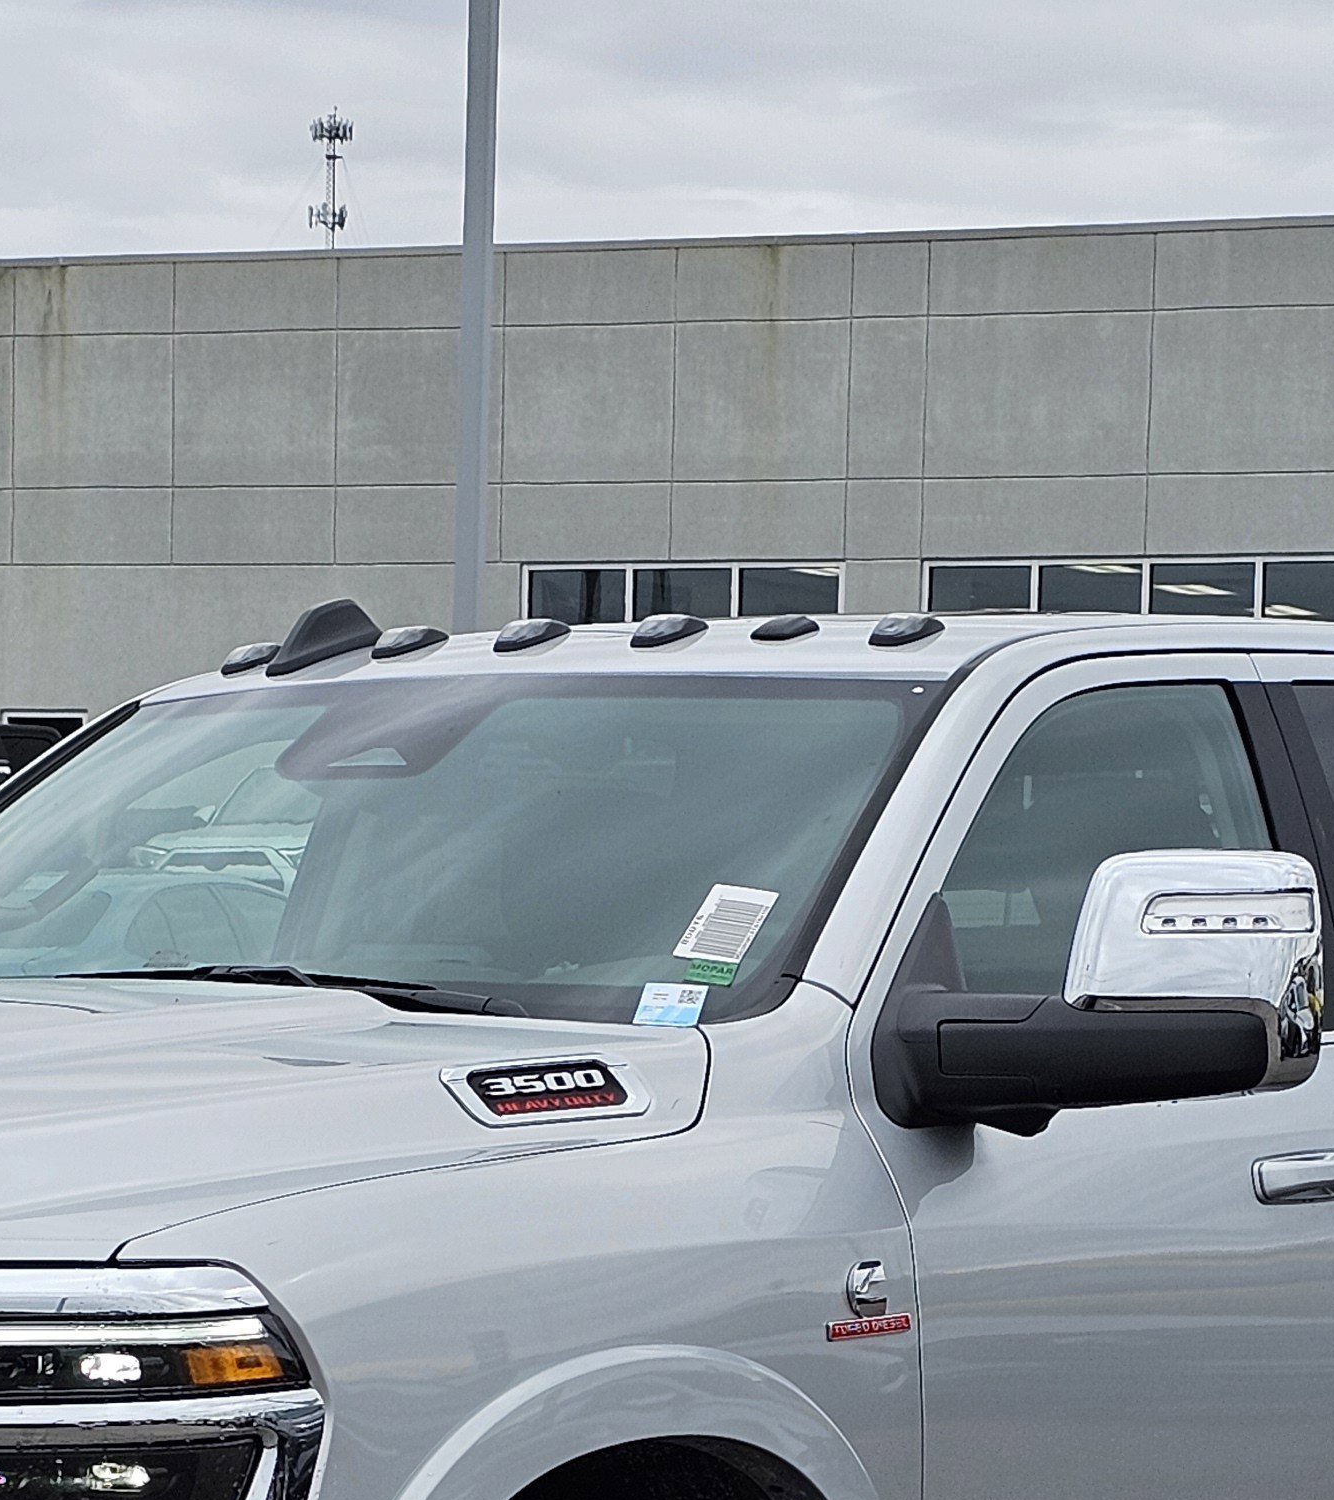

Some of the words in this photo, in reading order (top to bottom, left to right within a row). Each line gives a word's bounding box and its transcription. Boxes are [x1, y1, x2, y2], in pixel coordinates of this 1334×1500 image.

[481, 1069, 606, 1096] 3500
[495, 1097, 562, 1113] HEAVY
[564, 1092, 616, 1106] DUTY
